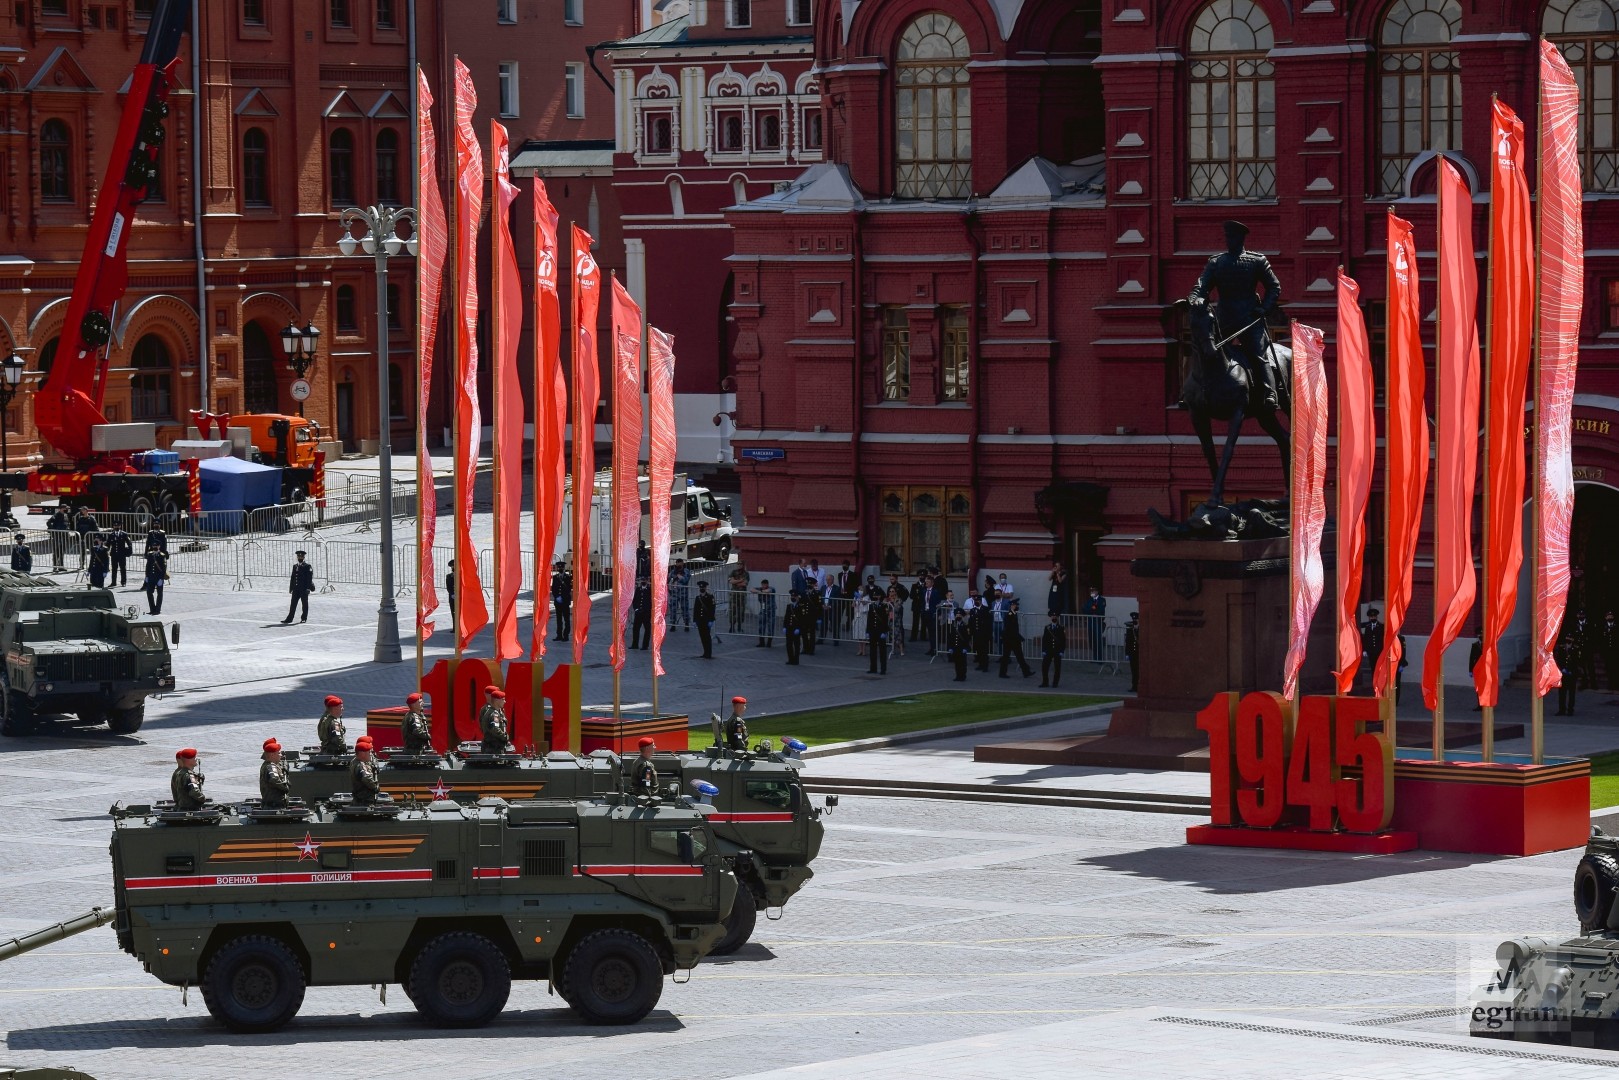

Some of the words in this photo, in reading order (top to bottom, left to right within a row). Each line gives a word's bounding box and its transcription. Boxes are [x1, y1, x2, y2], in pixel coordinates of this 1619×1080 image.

[1196, 691, 1392, 832] 1945
[216, 876, 258, 885] ВОЕННАЯ
[311, 873, 352, 882] ПОЛИЦИЯ
